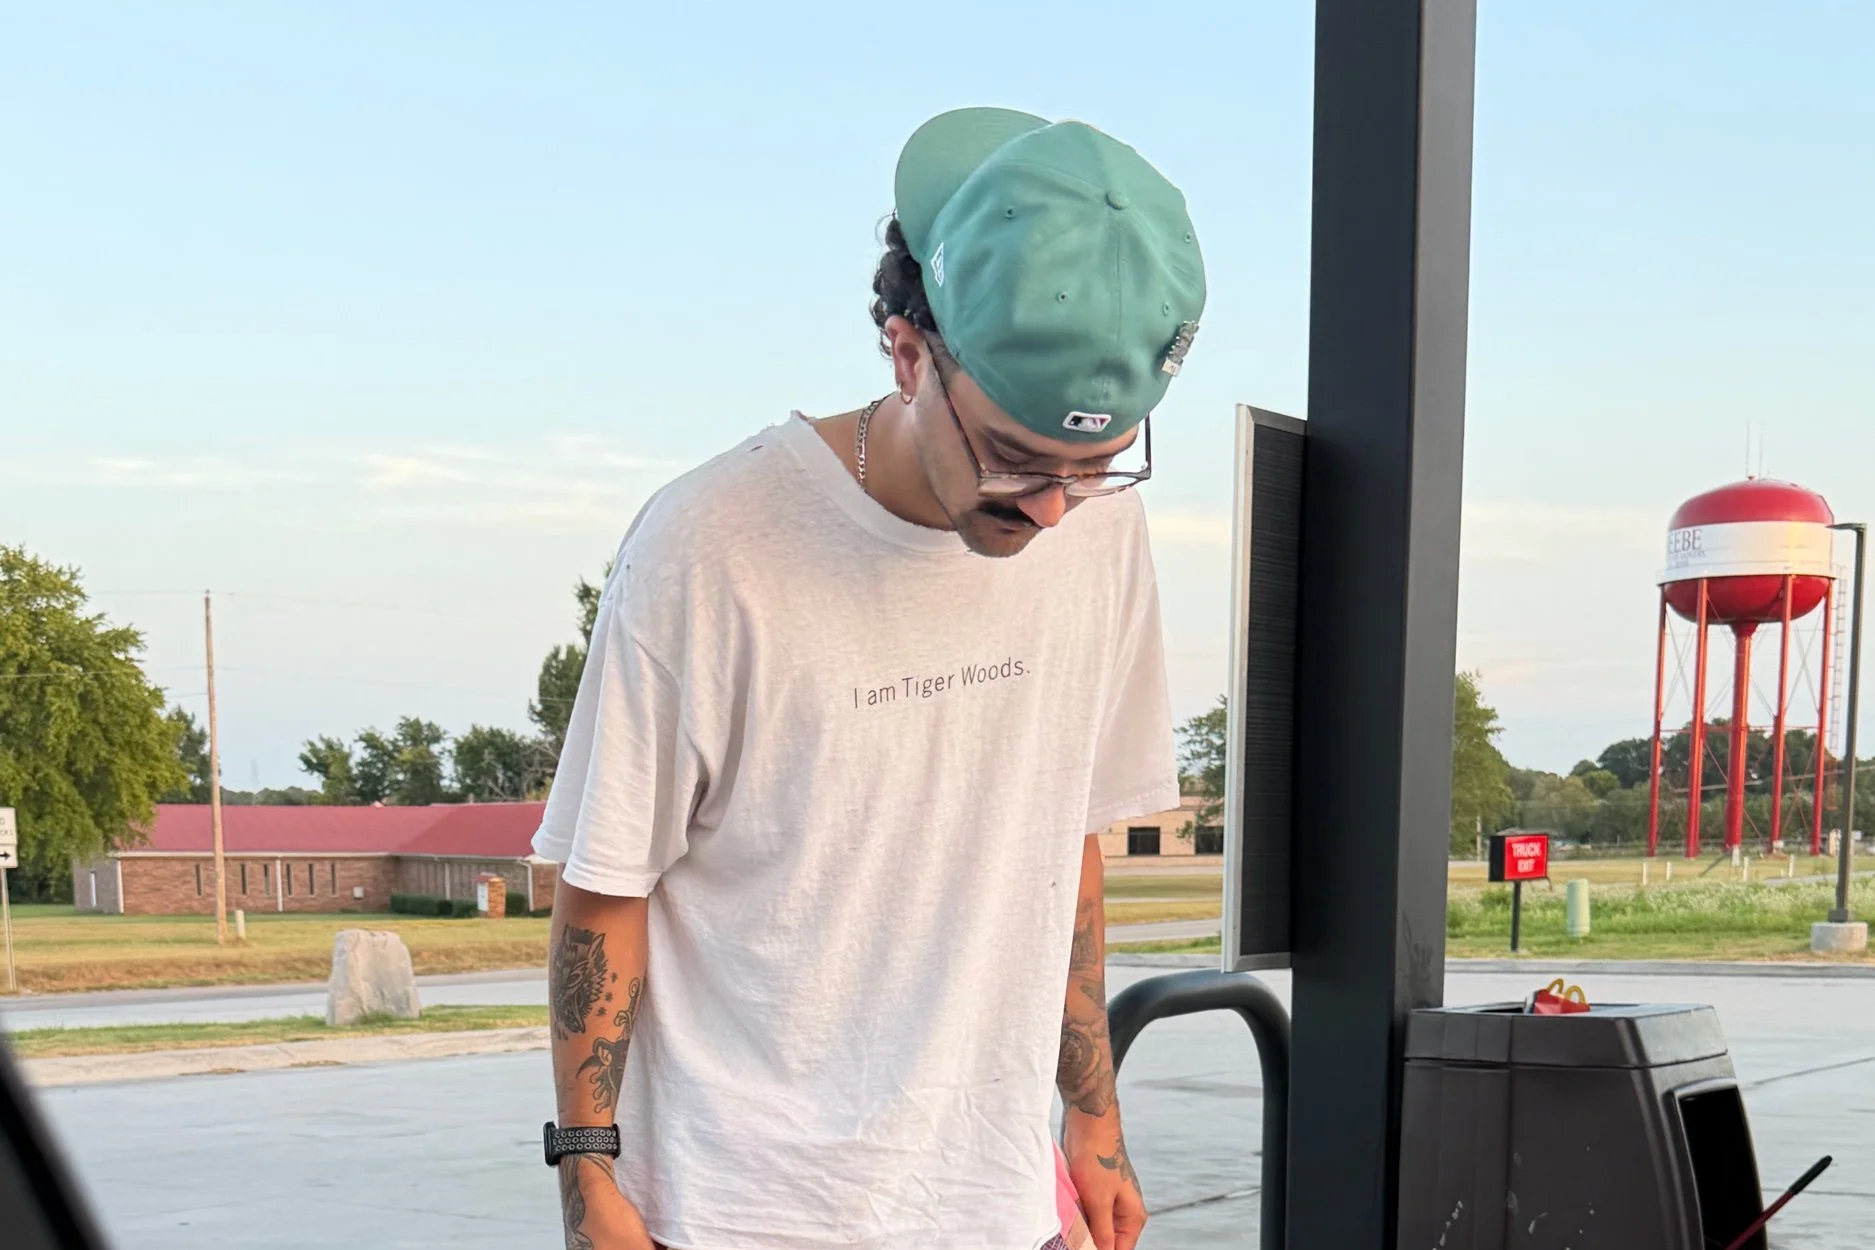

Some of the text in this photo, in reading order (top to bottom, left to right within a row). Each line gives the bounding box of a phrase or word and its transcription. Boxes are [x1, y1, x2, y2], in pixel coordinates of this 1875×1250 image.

[867, 685, 896, 706] am
[901, 673, 955, 698] Tiger
[961, 657, 1031, 686] Woods.
[1511, 841, 1542, 858] TRUCK
